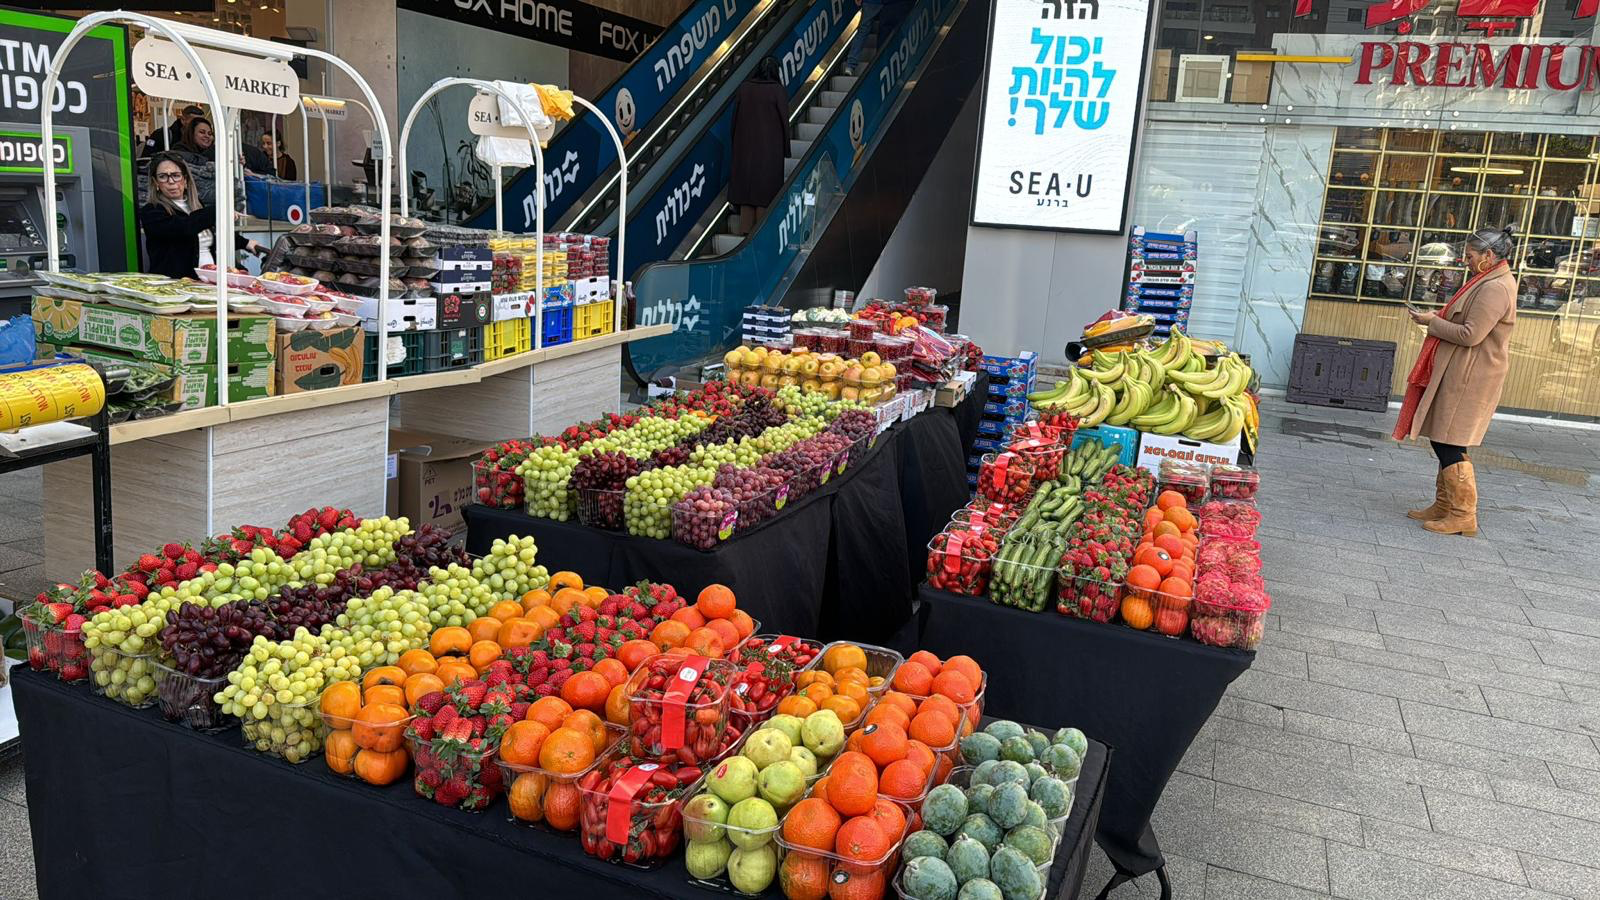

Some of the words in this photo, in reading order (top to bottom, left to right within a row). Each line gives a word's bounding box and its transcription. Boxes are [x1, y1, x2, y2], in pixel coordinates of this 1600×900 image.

[501, 0, 573, 36] HOME
[1041, 0, 1100, 20] הזה
[600, 21, 639, 53] FOX
[654, 4, 721, 93] משפחה
[779, 8, 829, 88] משפח
[879, 7, 930, 101] משפחה
[1031, 27, 1104, 65] יכול
[145, 61, 180, 81] SEA
[225, 75, 290, 98] MARKET
[1008, 61, 1118, 99] להיות
[474, 111, 491, 123] SEA
[1007, 91, 1111, 135] שלך!
[656, 181, 690, 246] כללית
[1037, 199, 1069, 208] ברנע
[641, 298, 683, 332] כללית
[1144, 445, 1194, 461] אפרסמון
